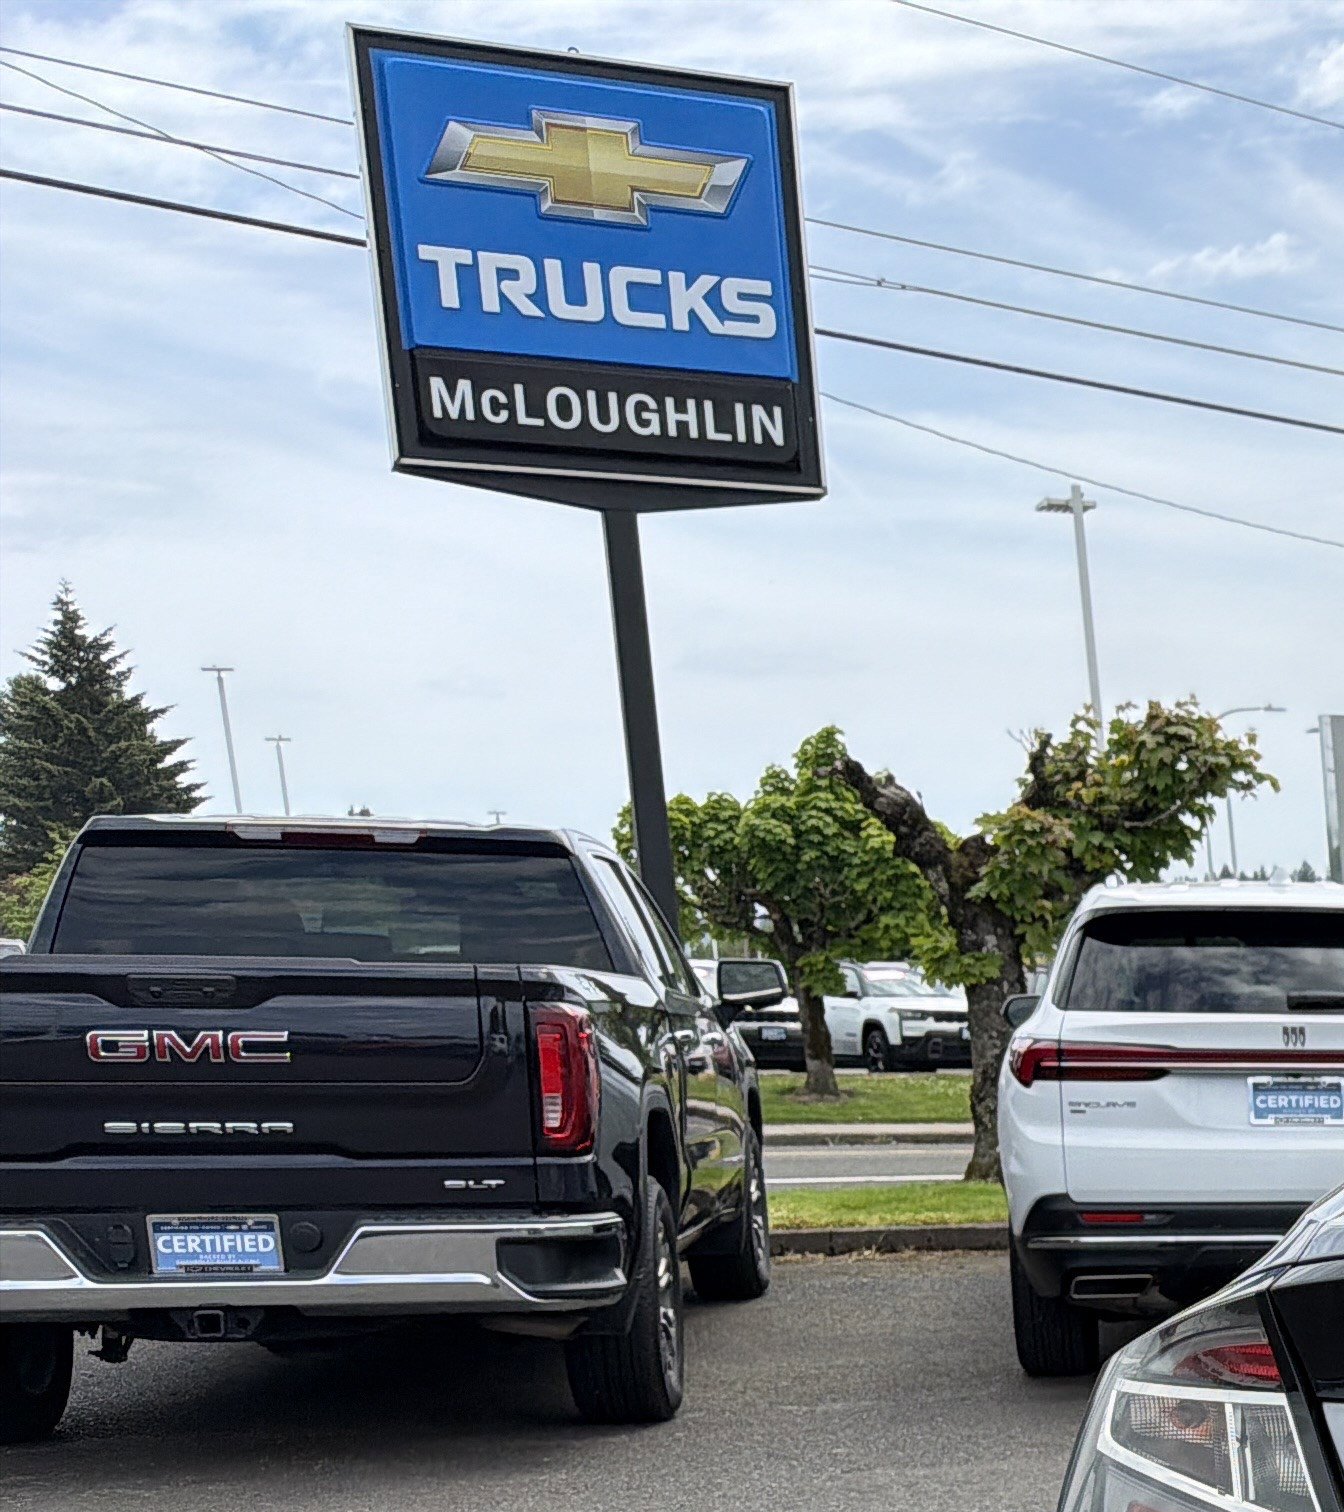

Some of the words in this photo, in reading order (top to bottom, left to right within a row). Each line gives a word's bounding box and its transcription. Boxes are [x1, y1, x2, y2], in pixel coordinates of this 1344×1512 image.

[417, 244, 777, 340] TRUCKS
[428, 376, 786, 447] McLOUGHLIN
[85, 1029, 292, 1064] GMC
[1255, 1095, 1341, 1109] CERTIFIED
[103, 1122, 294, 1135] SIERRA
[443, 1179, 506, 1189] SLT
[156, 1234, 275, 1254] CERTIFIED
